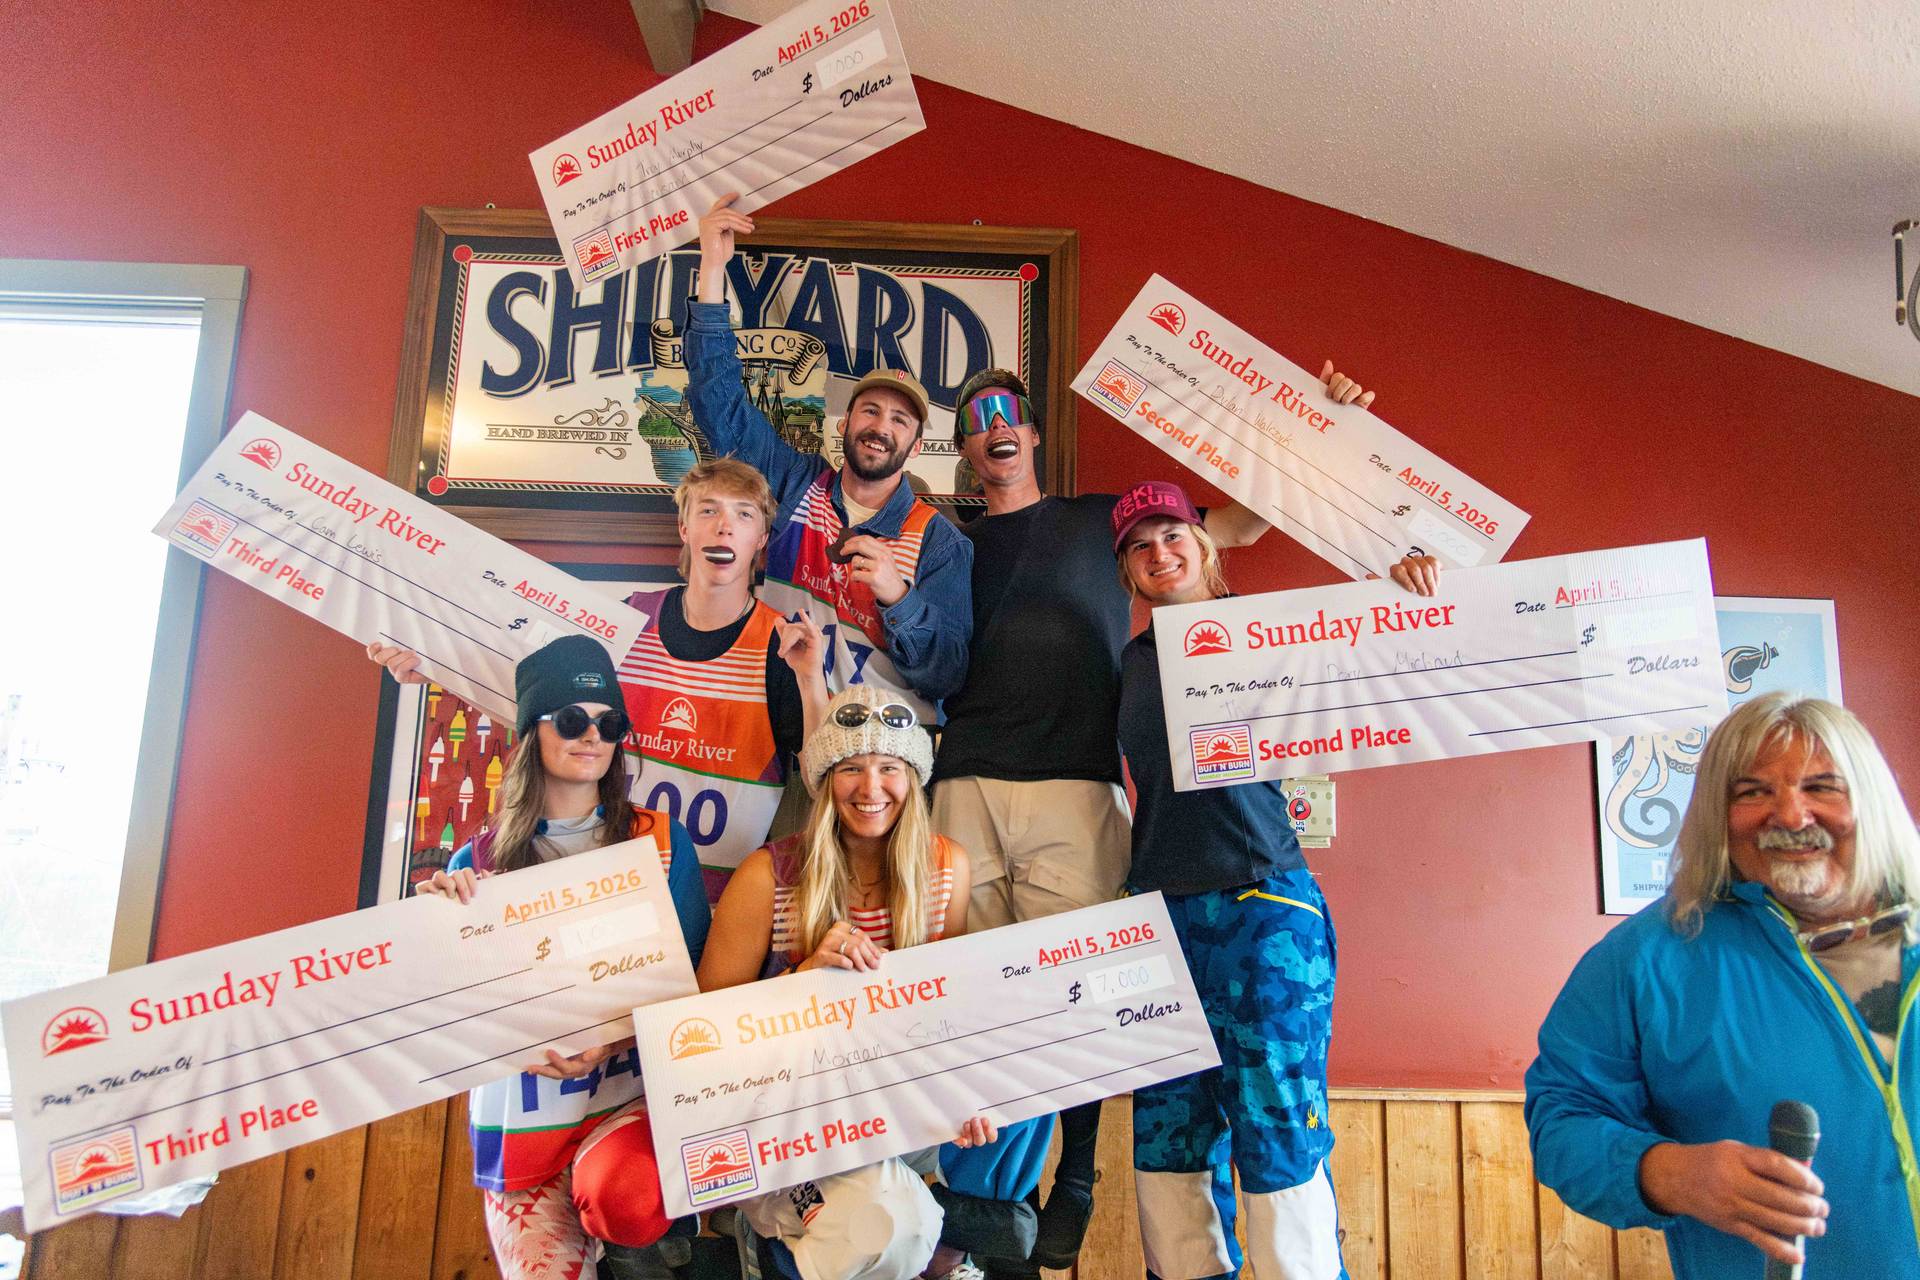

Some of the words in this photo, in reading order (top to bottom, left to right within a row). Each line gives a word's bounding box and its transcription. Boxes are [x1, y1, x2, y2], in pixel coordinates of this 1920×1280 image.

[752, 66, 774, 82] Date
[778, 31, 812, 64] April
[814, 25, 829, 43] 5,
[831, 0, 870, 34] 2026
[803, 72, 813, 94] $
[840, 74, 893, 108] Dollars
[587, 120, 658, 168] Sunday
[660, 88, 716, 131] River
[563, 209, 577, 219] Pay
[577, 203, 586, 211] To
[586, 197, 598, 207] The
[599, 189, 616, 201] Order
[618, 182, 626, 192] Of
[614, 226, 649, 252] First
[649, 209, 689, 237] Place
[1126, 335, 1142, 349] Pay
[1144, 345, 1152, 355] To
[1154, 352, 1166, 365] The
[1167, 363, 1187, 379] Order
[1188, 377, 1200, 387] Of
[1189, 329, 1274, 396] Sunday
[1271, 383, 1335, 434] River
[487, 427, 534, 439] HAND
[537, 429, 607, 441] BREWED
[610, 431, 629, 442] IN
[923, 442, 959, 452] MAIN
[1136, 401, 1198, 449] Second
[1196, 440, 1241, 481] Place
[215, 473, 231, 487] Pay
[246, 488, 260, 500] The
[260, 498, 283, 513] Order
[284, 510, 298, 520] Of
[286, 462, 378, 525] Sunday
[376, 507, 446, 557] River
[1122, 485, 1153, 507] SKI
[1123, 494, 1178, 517] CLUB
[1369, 454, 1392, 474] Date
[1399, 466, 1440, 498] April
[1438, 492, 1453, 510] 5,
[1455, 502, 1499, 535] 2026
[226, 537, 277, 575] Third
[275, 564, 325, 601] Place
[482, 570, 507, 588] Date
[514, 580, 557, 609] April
[555, 600, 571, 618] 5,
[574, 609, 619, 639] 2026
[1515, 602, 1547, 614] Date
[1555, 580, 1603, 607] April
[508, 617, 529, 630] $
[1247, 610, 1363, 650] Sunday
[1370, 602, 1455, 634] River
[1580, 624, 1597, 647] $
[1627, 654, 1701, 675] Dollars
[1186, 687, 1208, 699] Pay
[1211, 684, 1223, 695] To
[1227, 682, 1245, 693] The
[1248, 679, 1278, 691] Order
[1281, 676, 1294, 688] Of
[687, 738, 736, 762] River
[1259, 729, 1343, 761] Second
[1351, 724, 1412, 750] Place
[1228, 760, 1250, 769] BURN
[624, 774, 728, 846] 00
[460, 922, 495, 939] Date
[504, 890, 557, 923] April
[561, 887, 582, 906] 5,
[585, 869, 642, 899] 2026
[1633, 883, 1665, 891] SHIPYA
[536, 937, 551, 961] $
[589, 950, 665, 982] Dollars
[1002, 964, 1031, 979] Date
[1038, 939, 1081, 966] April
[1086, 936, 1106, 955] 5,
[1107, 922, 1155, 949] 2026
[130, 971, 281, 1033] Sunday
[290, 941, 393, 989] River
[1069, 981, 1082, 1004] $
[1096, 965, 1150, 994] 7,000
[736, 994, 857, 1045] Sunday
[862, 976, 947, 1015] River
[1116, 1000, 1183, 1027] Dollars
[811, 1043, 887, 1074] Morgan
[41, 1095, 72, 1110] Pay
[76, 1084, 96, 1098] To
[100, 1077, 125, 1091] The
[130, 1066, 171, 1082] Order
[175, 1056, 193, 1070] Of
[674, 1094, 698, 1107] Pay
[701, 1087, 716, 1099] To
[719, 1082, 740, 1096] The
[743, 1075, 775, 1089] Order
[777, 1069, 792, 1083] Of
[145, 1117, 232, 1167] Third
[240, 1099, 320, 1138] Place
[758, 1132, 818, 1166] First
[822, 1116, 887, 1149] Place
